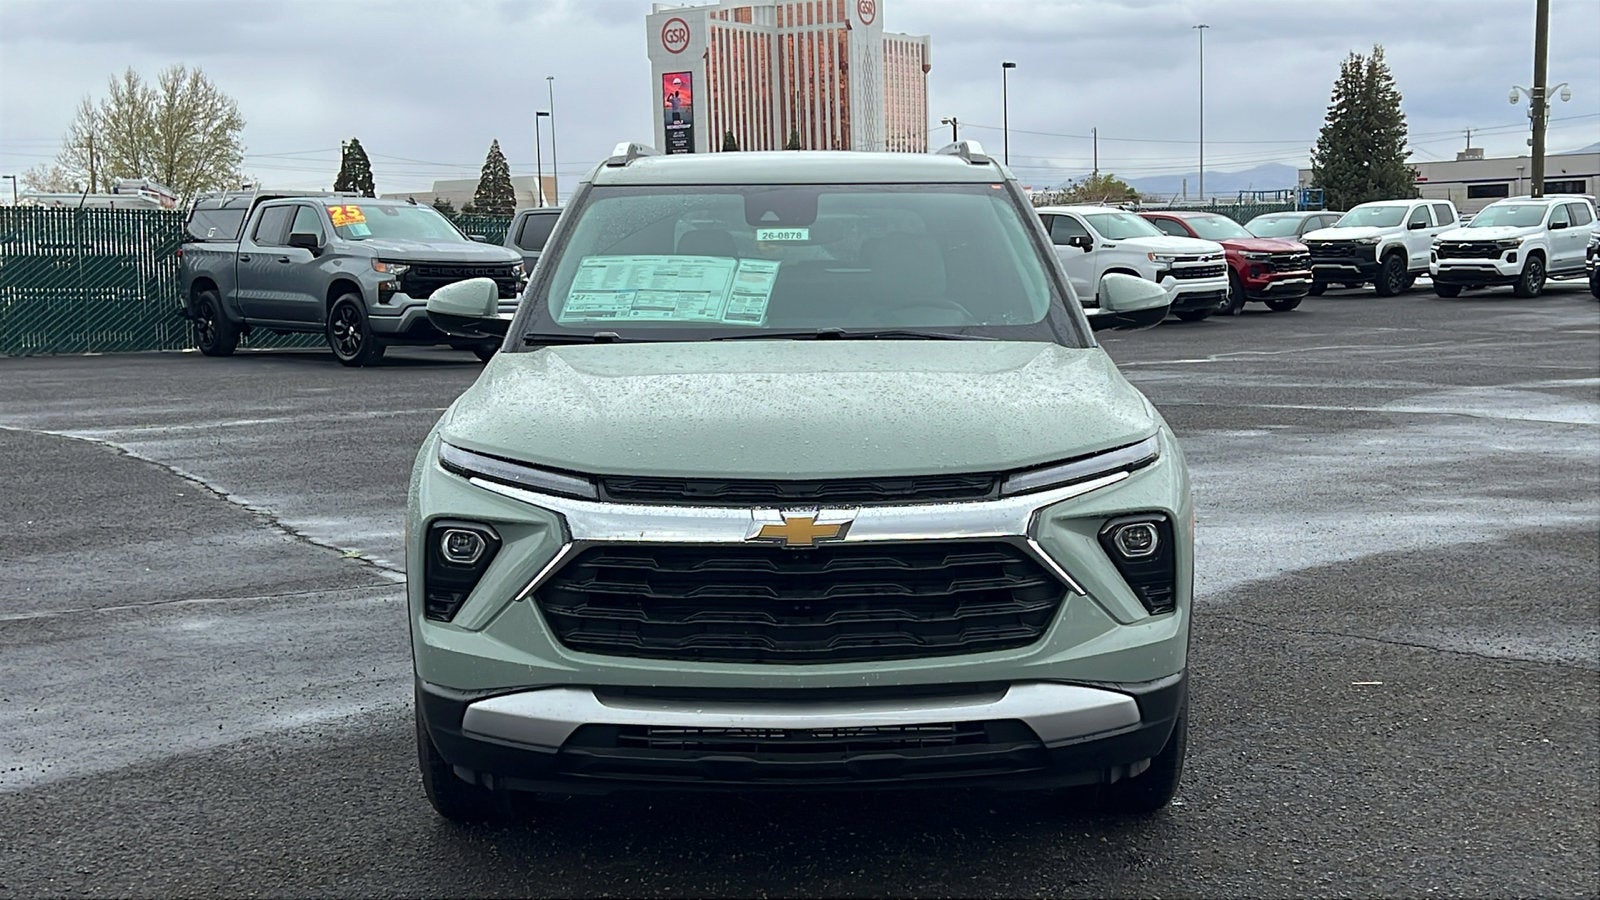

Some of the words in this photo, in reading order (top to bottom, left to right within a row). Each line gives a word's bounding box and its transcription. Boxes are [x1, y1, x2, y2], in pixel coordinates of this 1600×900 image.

[860, 0, 874, 15] GSR
[665, 28, 686, 43] GSR
[328, 205, 362, 219] 25
[762, 231, 802, 239] 26-0878
[416, 266, 511, 276] CHEVROLET
